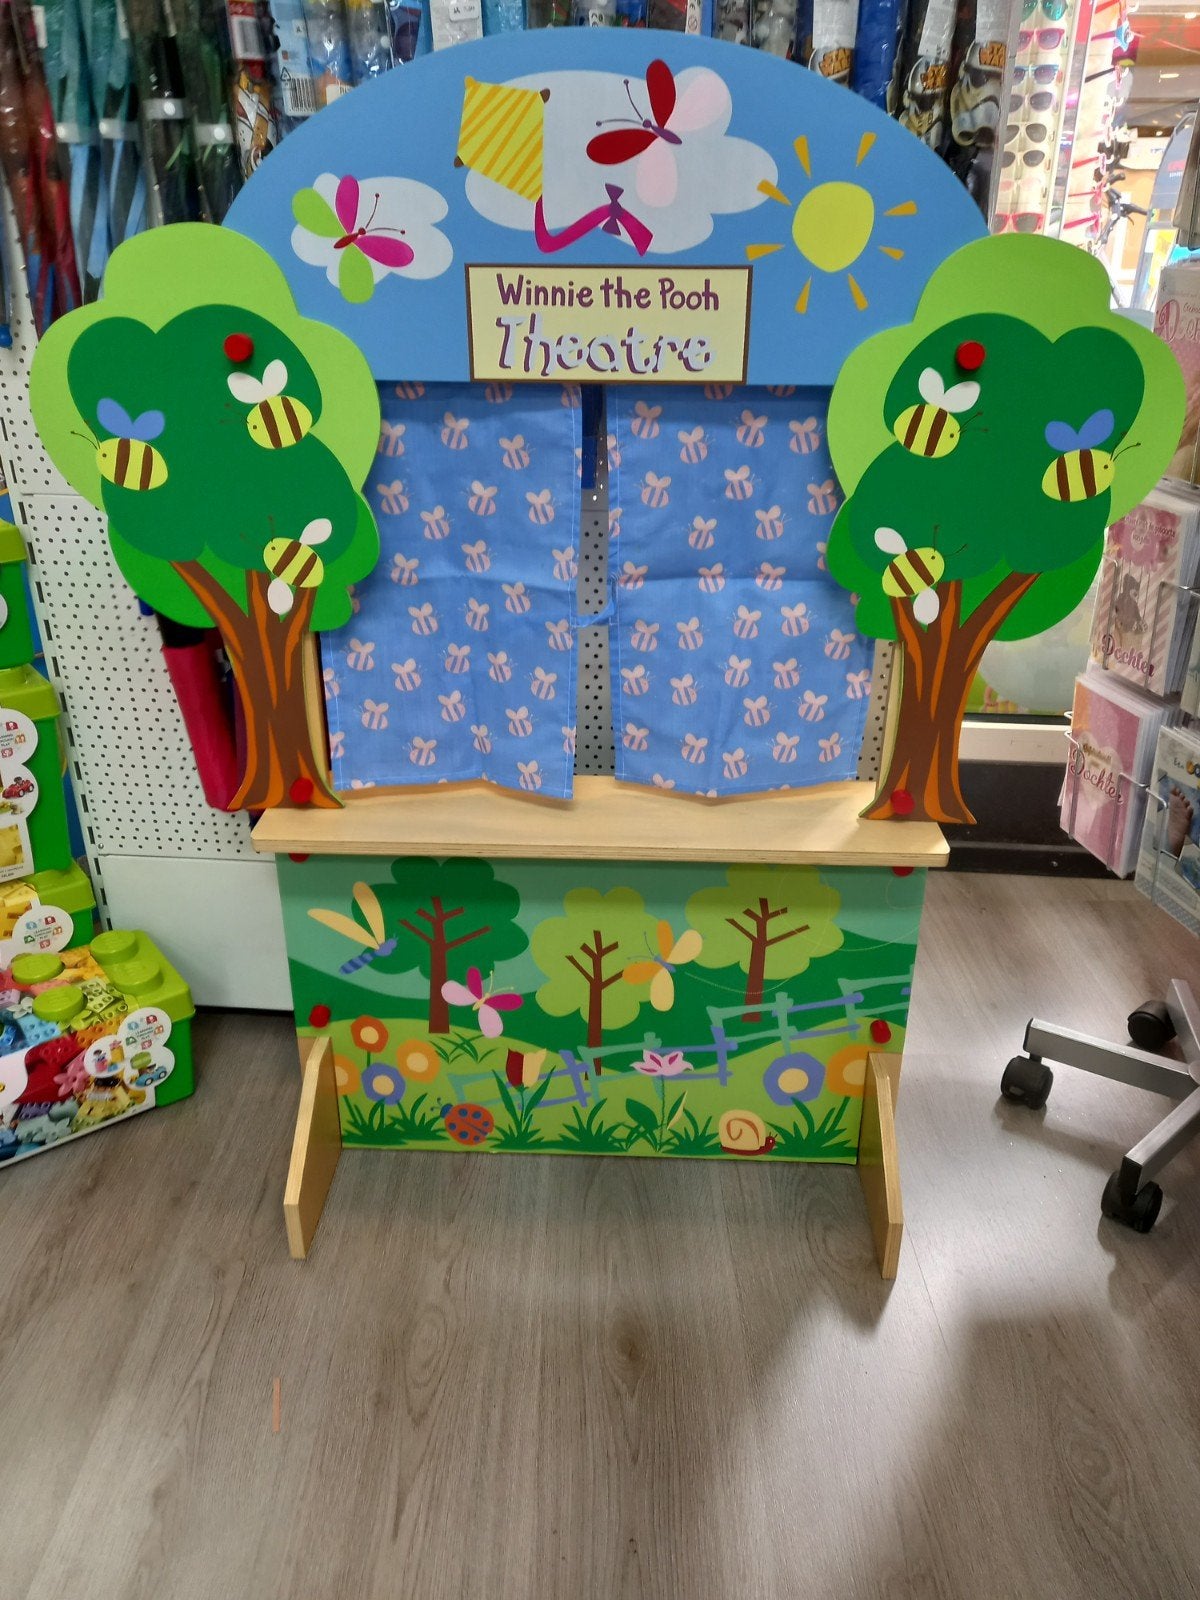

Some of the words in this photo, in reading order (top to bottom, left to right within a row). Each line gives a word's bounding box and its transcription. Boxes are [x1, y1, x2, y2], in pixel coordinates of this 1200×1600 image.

[496, 273, 594, 308] Winnie
[600, 276, 651, 308] the
[658, 277, 719, 311] Pooh
[495, 313, 717, 377] Theatre
[1070, 748, 1123, 803] Dochter
